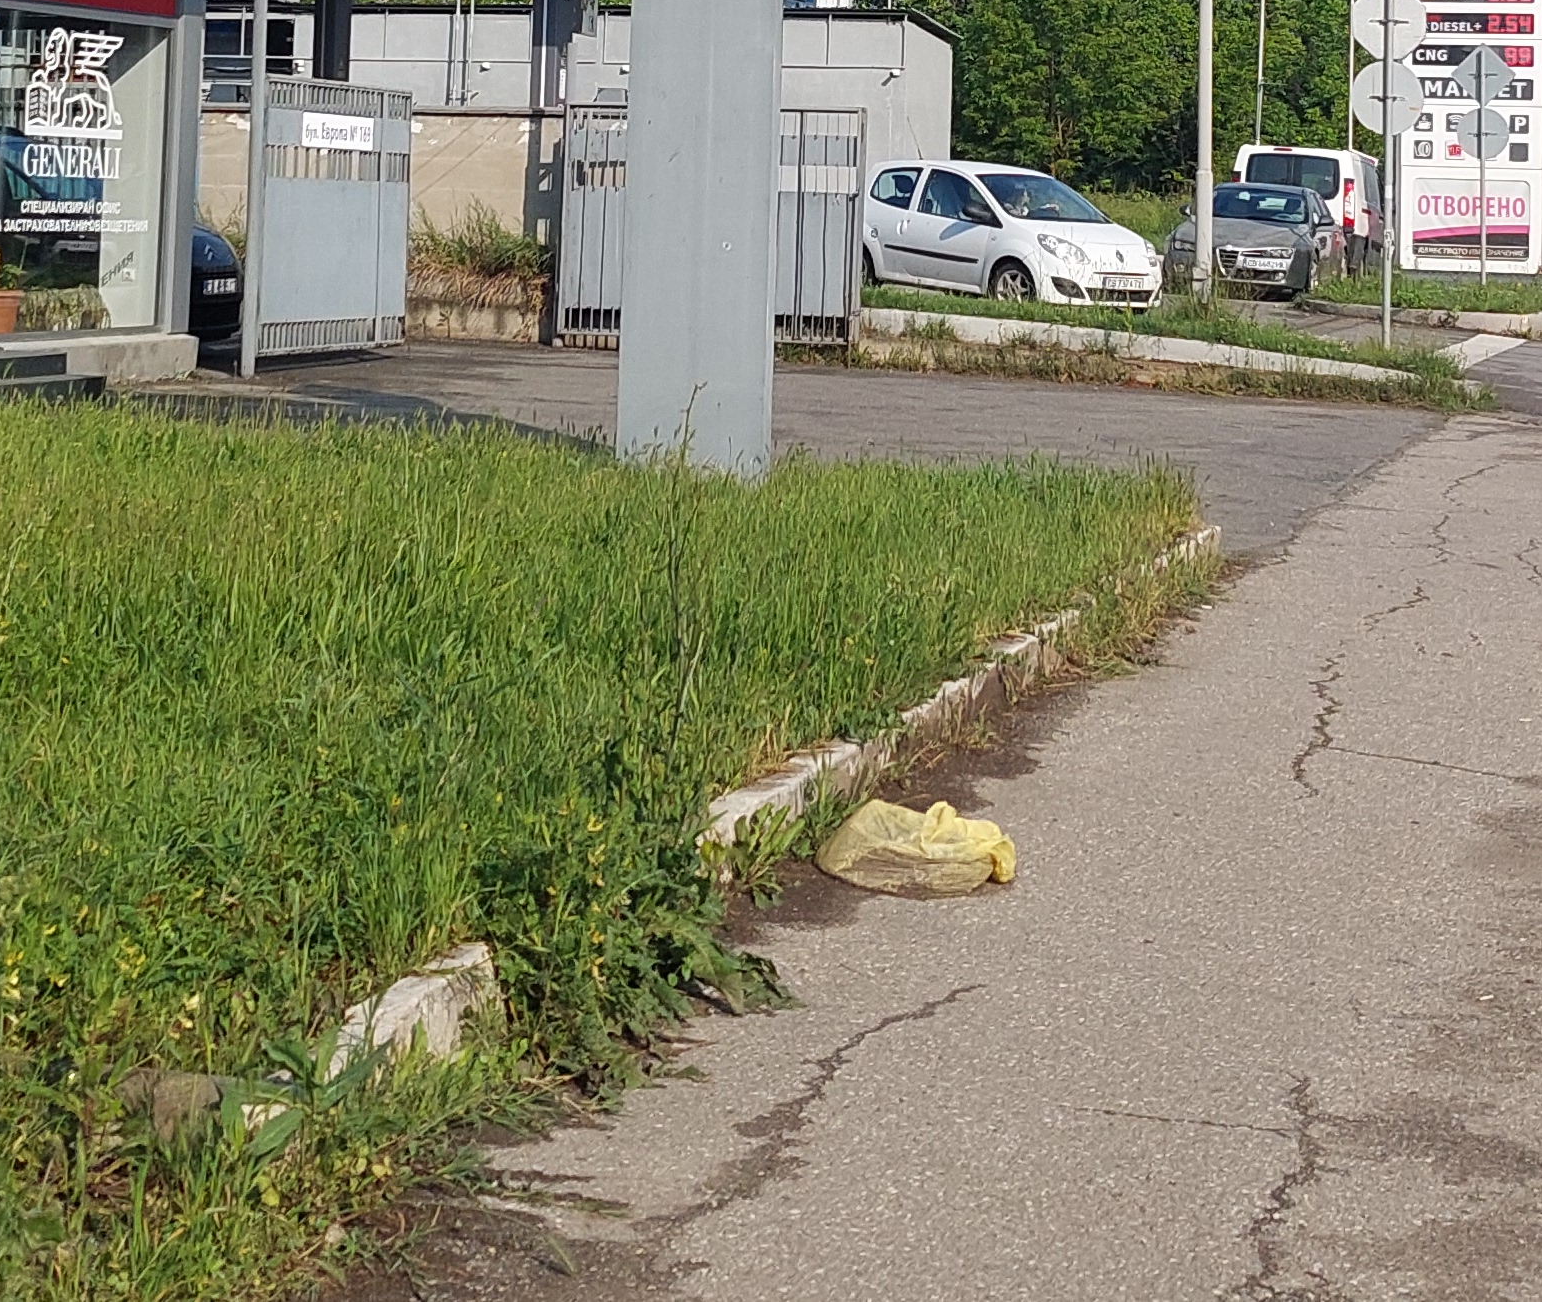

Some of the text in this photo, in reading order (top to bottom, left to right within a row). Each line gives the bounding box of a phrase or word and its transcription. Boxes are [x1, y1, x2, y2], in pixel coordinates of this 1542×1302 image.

[1415, 48, 1448, 61] CNG
[1424, 80, 1528, 98] MAET
[22, 143, 122, 179] GENERALI
[20, 200, 94, 214] СПЕЦИАЛИЗИРАН
[1417, 195, 1526, 218] ОТВОРЕНО
